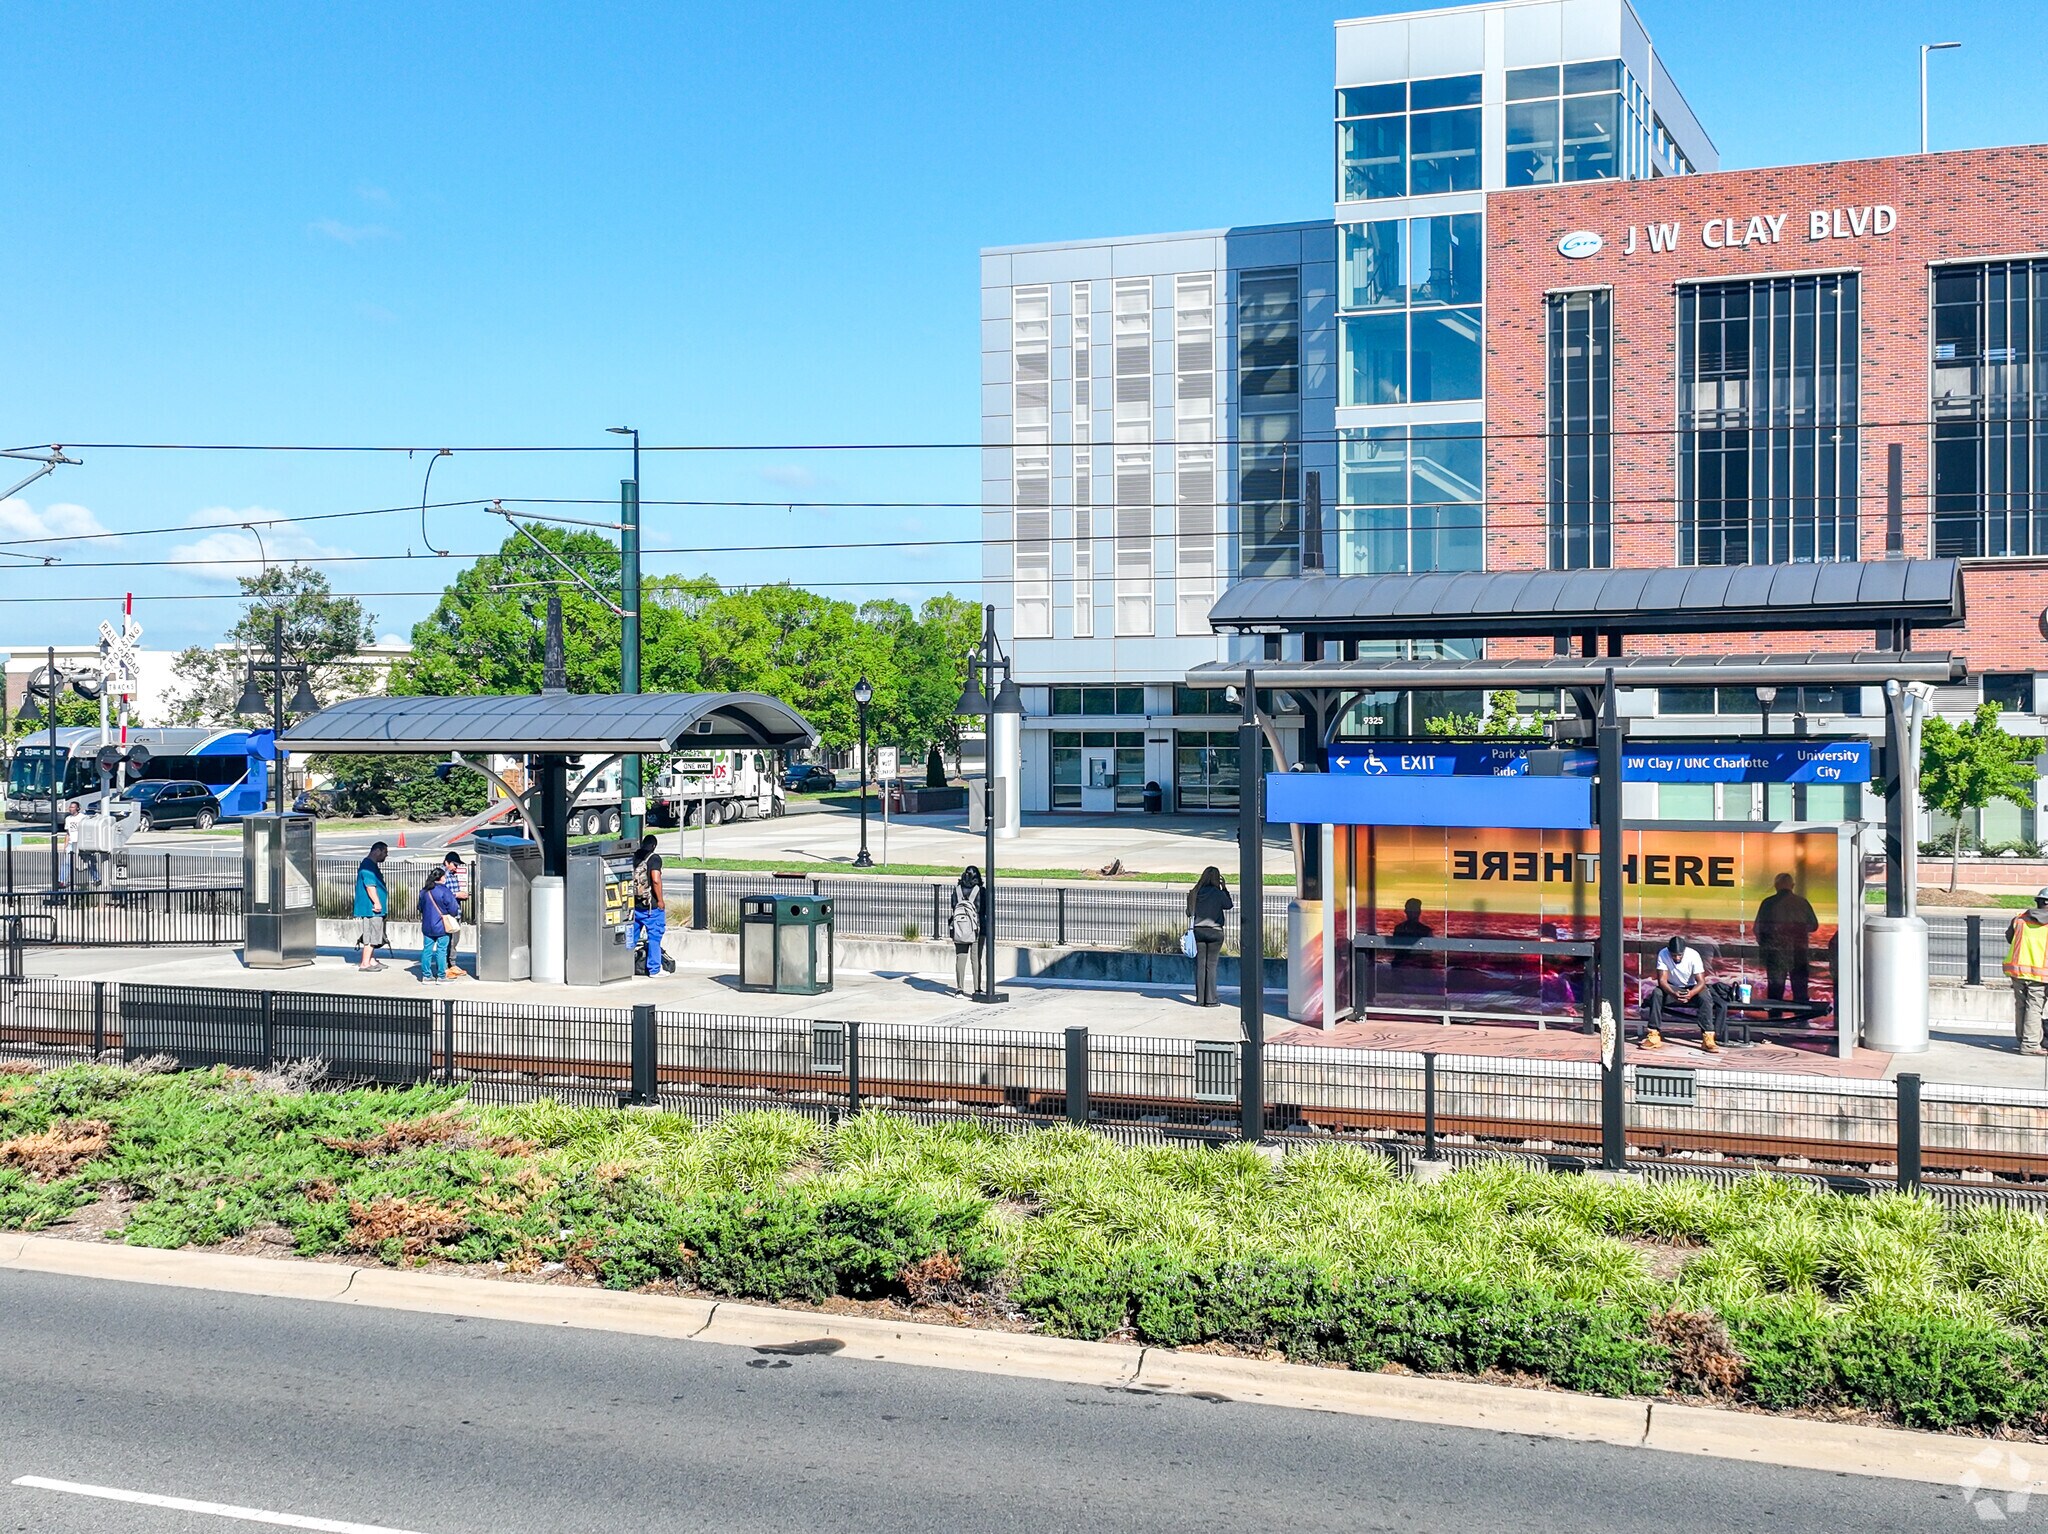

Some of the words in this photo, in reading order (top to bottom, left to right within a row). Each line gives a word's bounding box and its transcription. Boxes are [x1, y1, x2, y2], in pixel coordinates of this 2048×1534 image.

[1623, 226, 1637, 255] J
[1646, 222, 1681, 253] W
[1702, 213, 1788, 249] CLAY
[1809, 204, 1898, 242] BLVD
[101, 622, 117, 645] RAIL
[123, 652, 140, 674] ROAD
[118, 669, 124, 680] 2
[1363, 716, 1385, 726] 9325
[1492, 748, 1516, 760] Park
[1797, 750, 1860, 764] University
[1401, 754, 1436, 771] EXIT
[1627, 758, 1645, 769] JW
[1648, 757, 1673, 771] Clay
[1675, 758, 1681, 770] /
[1684, 758, 1710, 769] UNC
[1713, 757, 1769, 769] Charlotte
[1493, 766, 1518, 776] Ride
[1816, 766, 1841, 779] City
